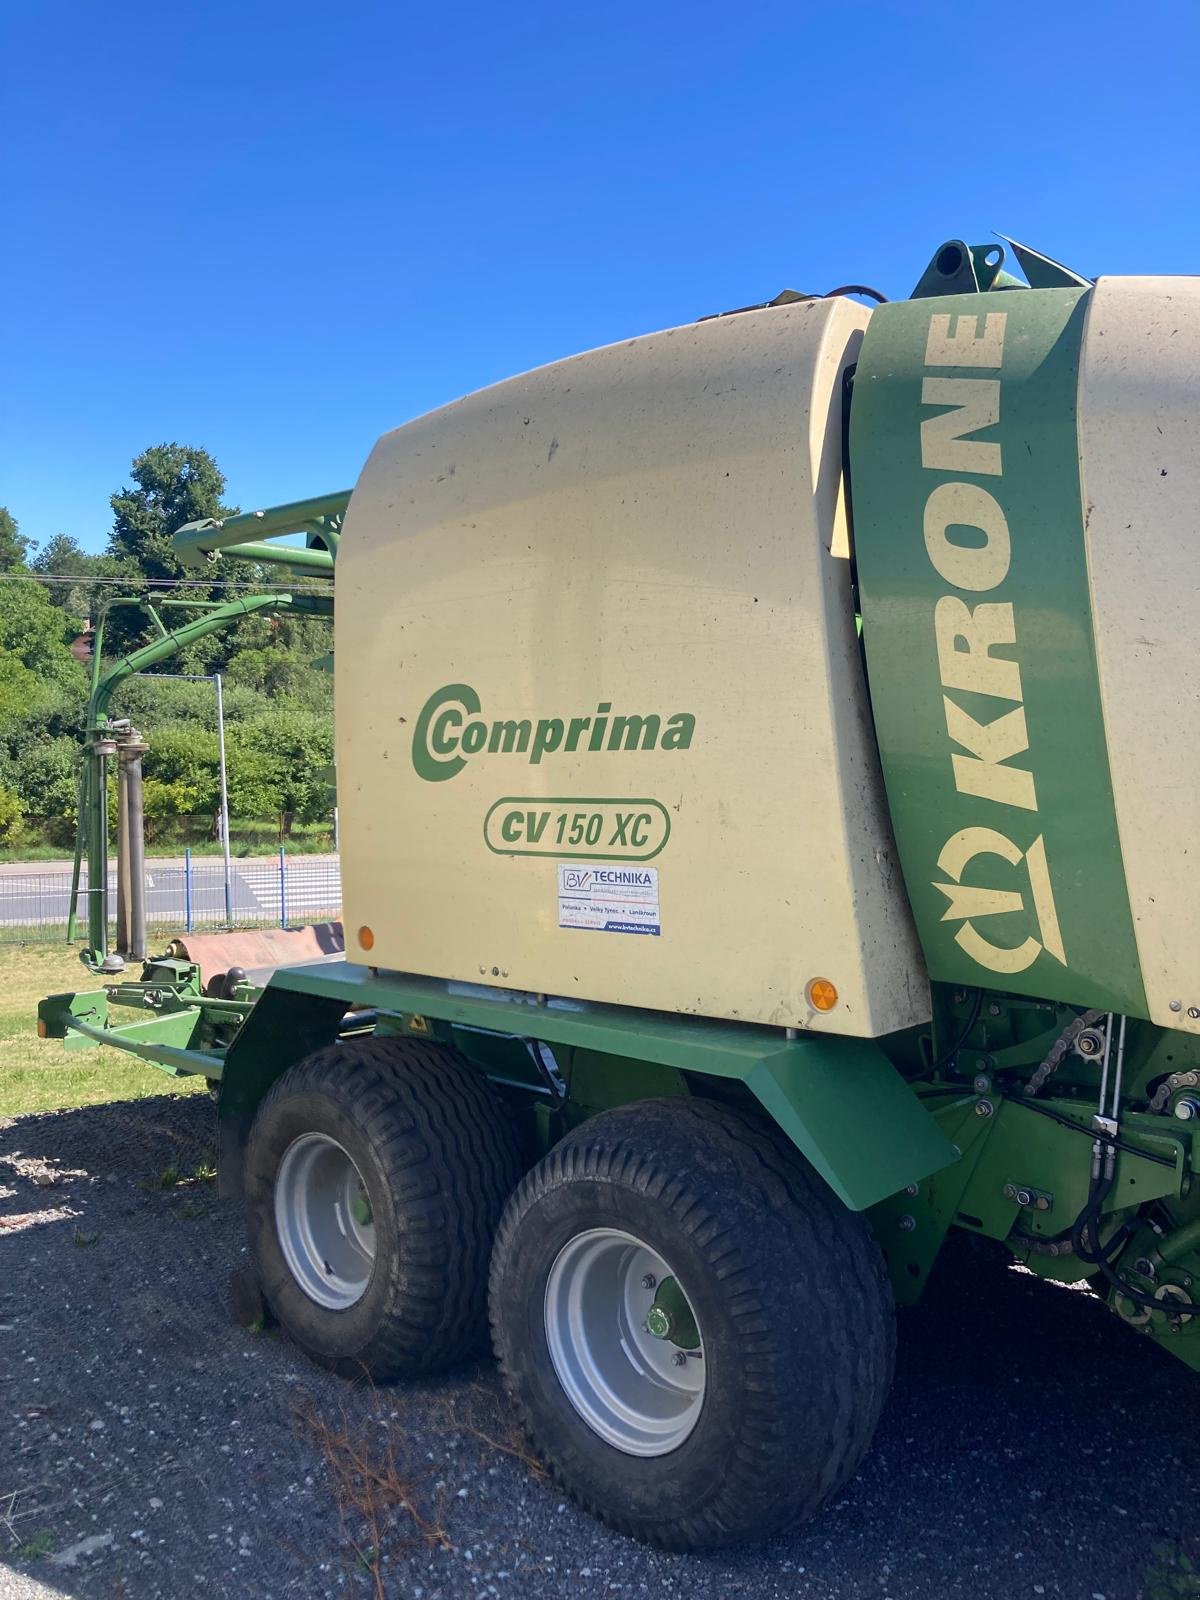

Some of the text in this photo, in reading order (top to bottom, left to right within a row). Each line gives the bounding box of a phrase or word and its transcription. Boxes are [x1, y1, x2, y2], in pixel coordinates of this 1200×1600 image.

[921, 312, 1038, 812] KRONE
[412, 684, 696, 782] Comprima
[501, 811, 652, 847] CV 150 XC
[593, 871, 652, 884] TECHNIKA
